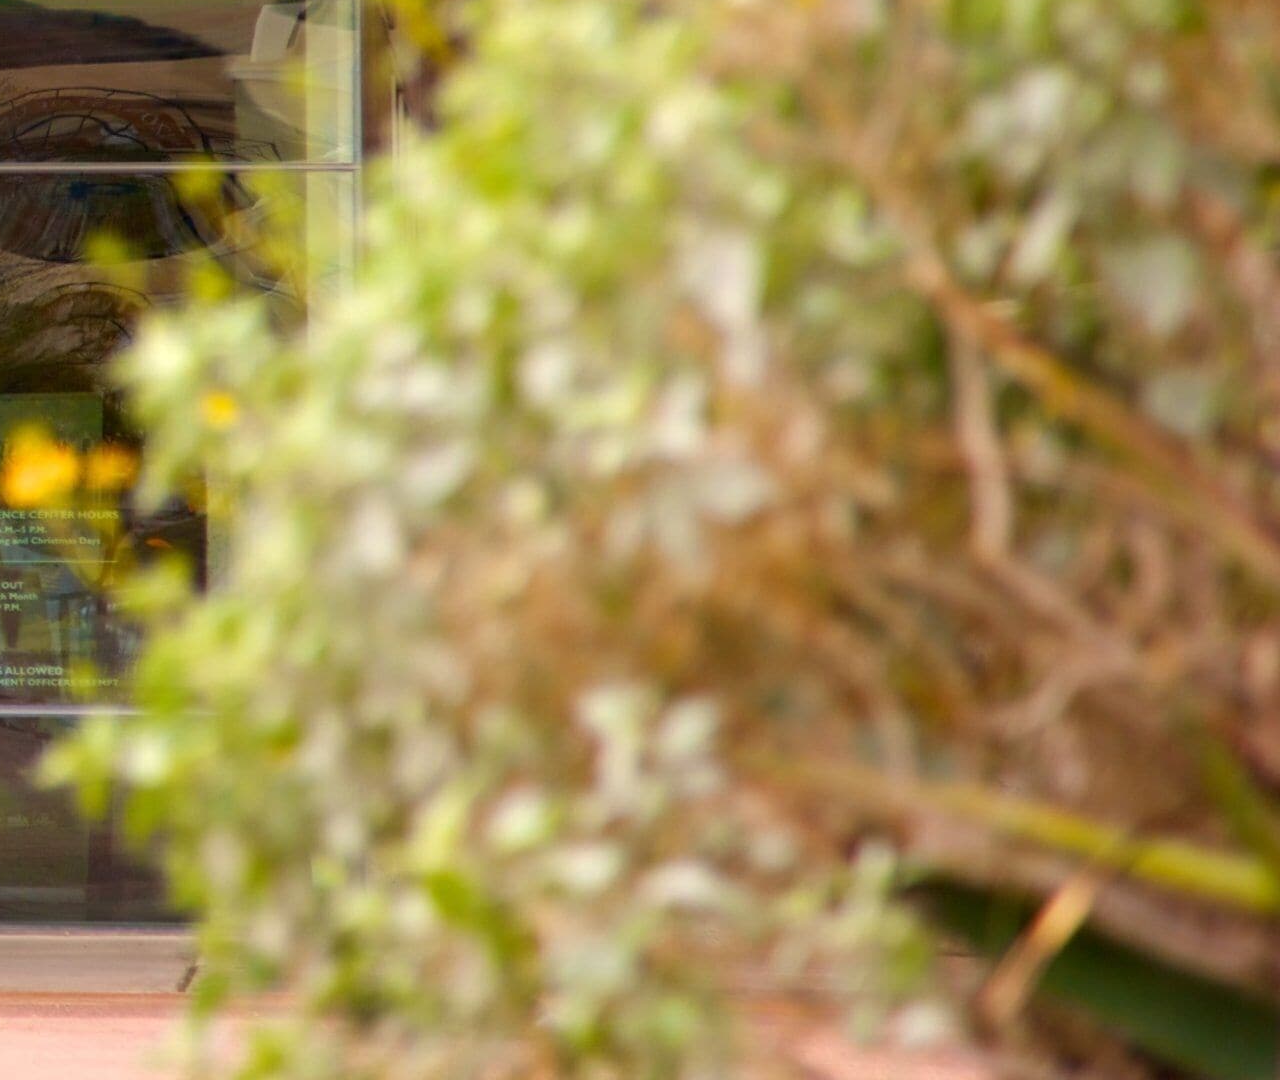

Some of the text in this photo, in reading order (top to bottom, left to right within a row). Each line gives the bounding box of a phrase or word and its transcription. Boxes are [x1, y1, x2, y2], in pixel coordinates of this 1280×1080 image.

[28, 510, 75, 520] CENTER
[78, 510, 119, 519] HOURS
[12, 537, 29, 545] and
[31, 536, 77, 545] Christmas
[1, 581, 24, 590] OUT
[9, 593, 38, 601] Month
[5, 666, 64, 676] ALLOWED
[78, 678, 119, 687] EMPT
